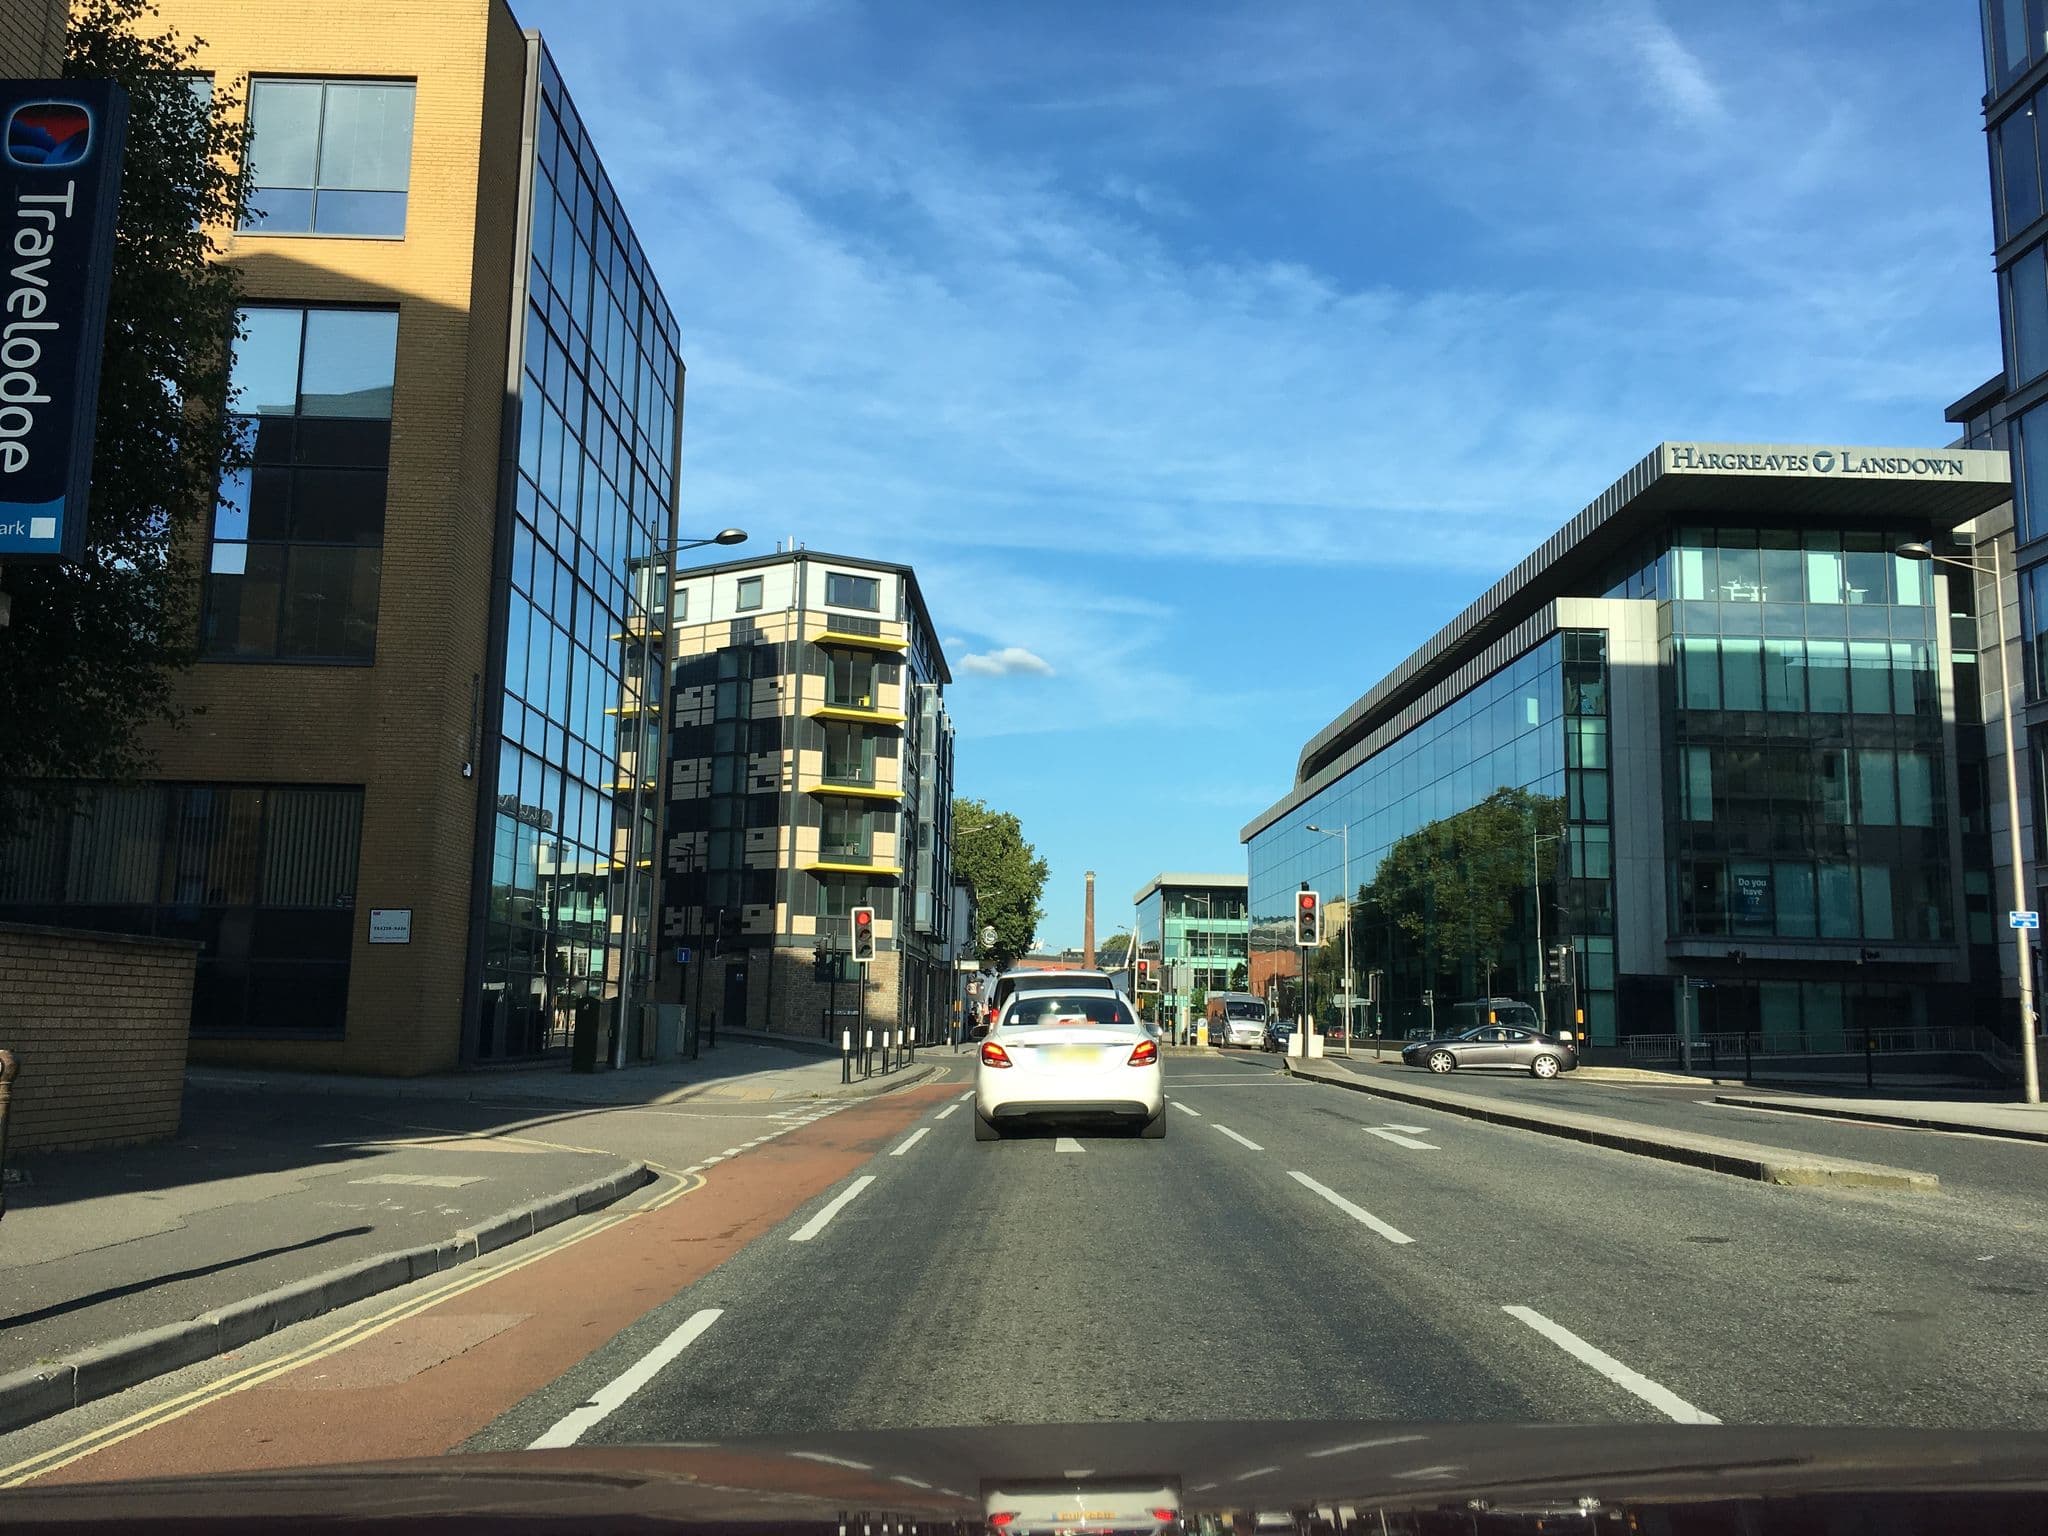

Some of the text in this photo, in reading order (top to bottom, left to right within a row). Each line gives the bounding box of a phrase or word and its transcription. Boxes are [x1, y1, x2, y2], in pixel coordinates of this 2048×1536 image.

[1671, 446, 1964, 476] HARGREAVES LANSDOWN
[1738, 878, 1767, 888] Do you
[1743, 887, 1763, 896] have
